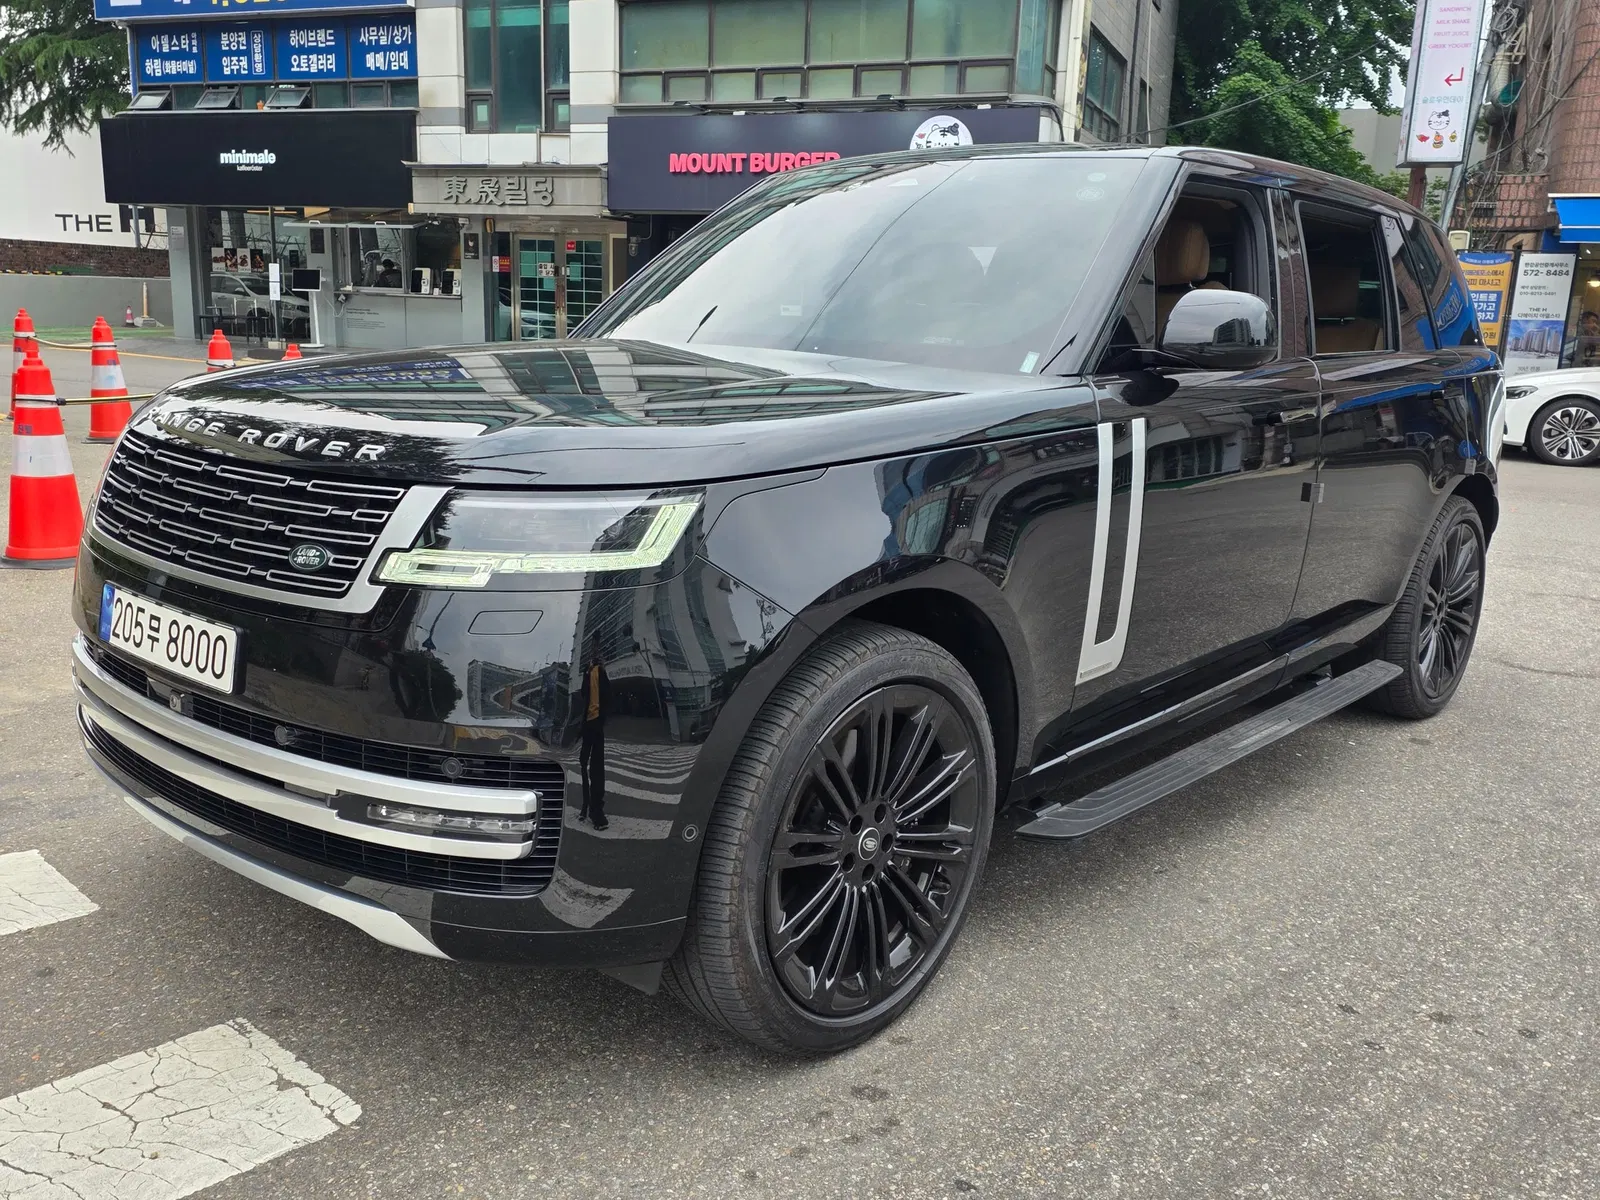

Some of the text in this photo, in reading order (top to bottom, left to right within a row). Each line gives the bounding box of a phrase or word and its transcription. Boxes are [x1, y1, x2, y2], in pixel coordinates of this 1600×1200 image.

[151, 34, 189, 53] 아델스타
[221, 32, 247, 50] 분양권
[289, 29, 335, 48] 하이브랜드
[360, 25, 412, 46] 사무실/상가
[253, 33, 263, 73] 상담환영
[366, 50, 409, 71] 매매/임대
[222, 56, 248, 74] 입주권
[291, 53, 336, 73] 오토갤러리
[220, 149, 276, 164] minimale
[669, 153, 747, 174] MOUNT
[55, 213, 113, 232] THE
[147, 406, 387, 461] RANGE ROVER
[296, 556, 320, 566] ROVER
[297, 548, 317, 557] LAND
[112, 597, 228, 680] 205무 8000
